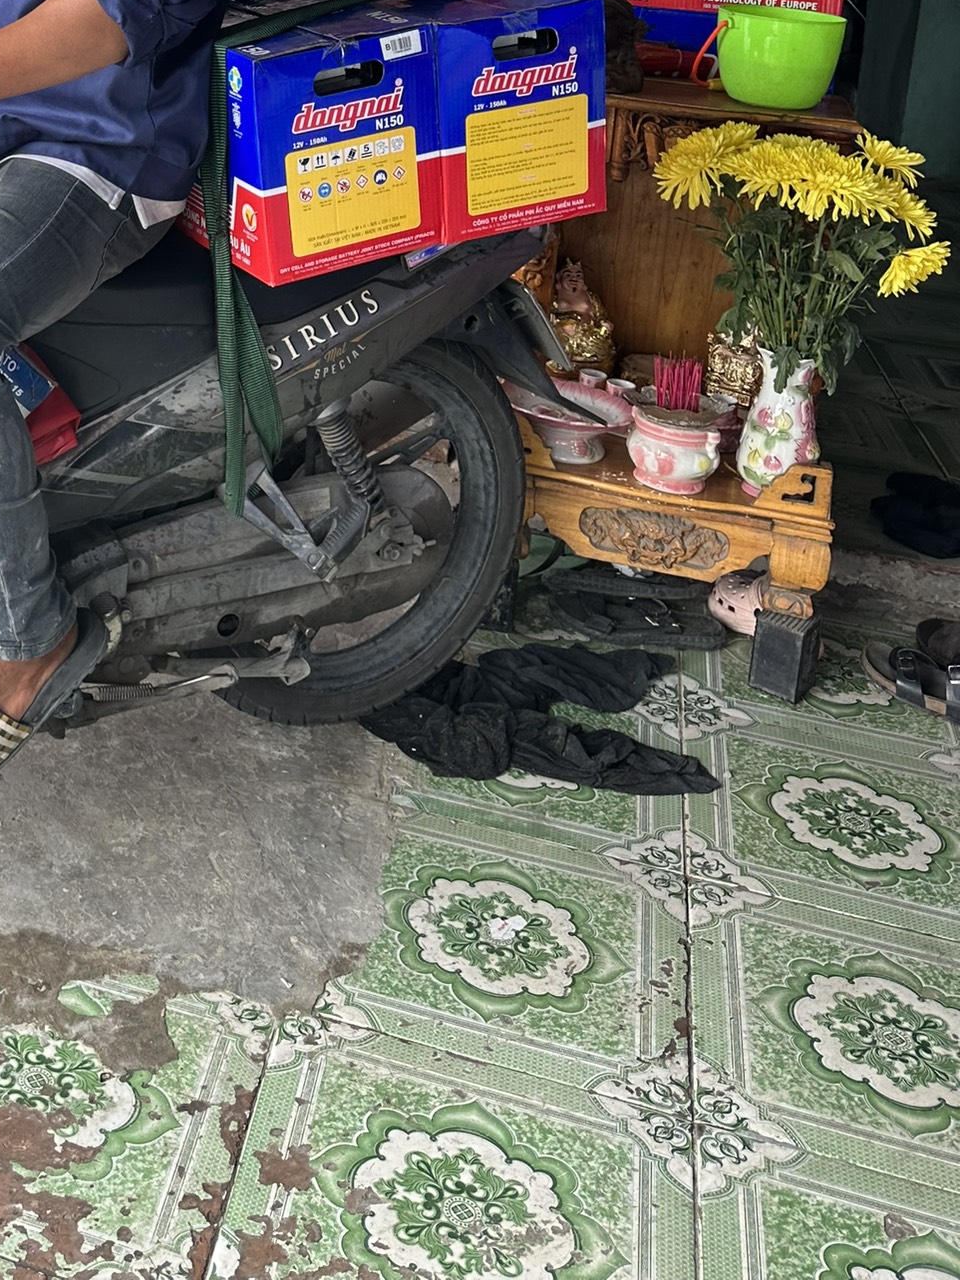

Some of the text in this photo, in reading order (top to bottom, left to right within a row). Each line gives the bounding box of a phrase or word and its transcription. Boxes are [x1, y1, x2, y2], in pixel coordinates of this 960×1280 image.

[766, 0, 778, 7] OF
[780, 0, 818, 11] EUROPE
[552, 83, 578, 97] N150
[293, 114, 404, 149] 12V 150Ah N150
[363, 144, 370, 153] 5
[472, 218, 490, 227] CÔNG
[571, 198, 585, 206] NAM
[266, 289, 379, 371] SIRIUS
[313, 344, 367, 380] SPECIAL
